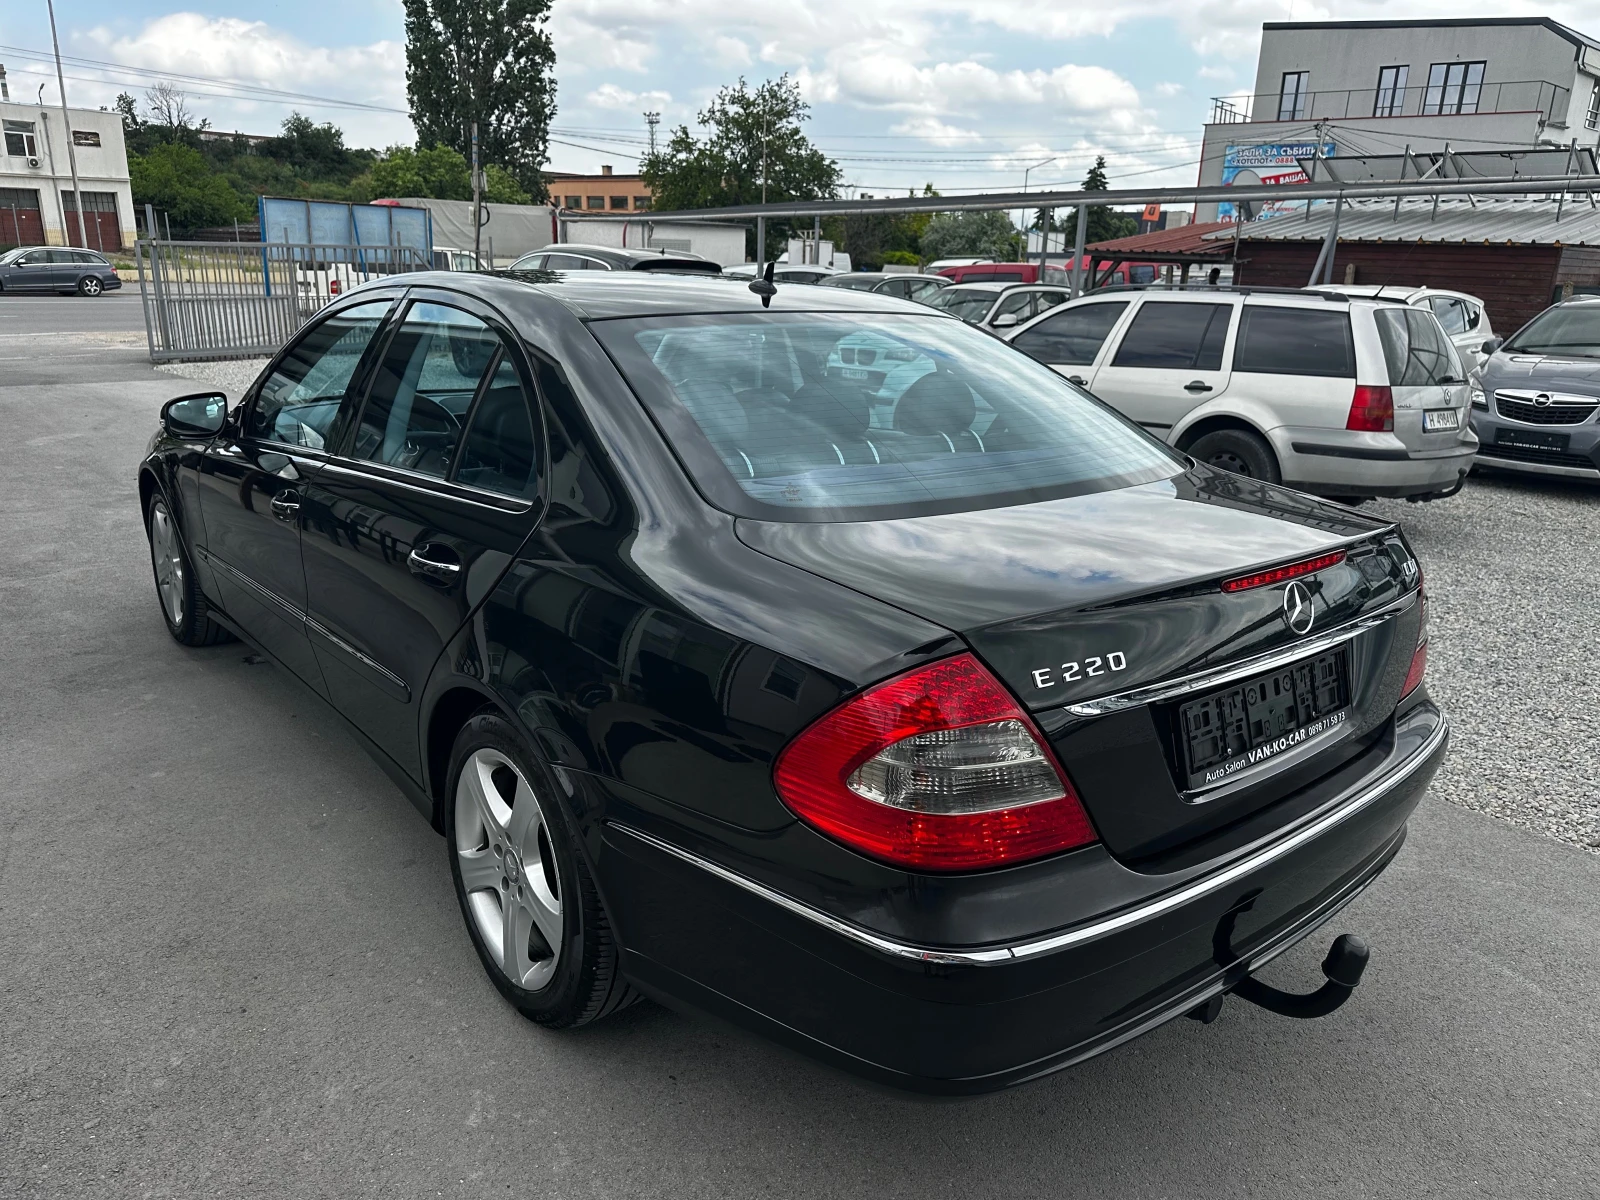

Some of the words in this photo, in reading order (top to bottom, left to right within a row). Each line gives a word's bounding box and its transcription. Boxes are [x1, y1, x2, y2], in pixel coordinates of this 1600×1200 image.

[1266, 148, 1277, 156] ЗА
[1031, 667, 1055, 690] E
[1061, 651, 1127, 683] 220
[1205, 768, 1225, 783] Auto
[1225, 759, 1246, 774] Salon
[1248, 728, 1306, 763] VAN-KO-CAR
[1322, 719, 1330, 730] 71
[1330, 715, 1338, 726] 58
[1338, 711, 1346, 722] 73
